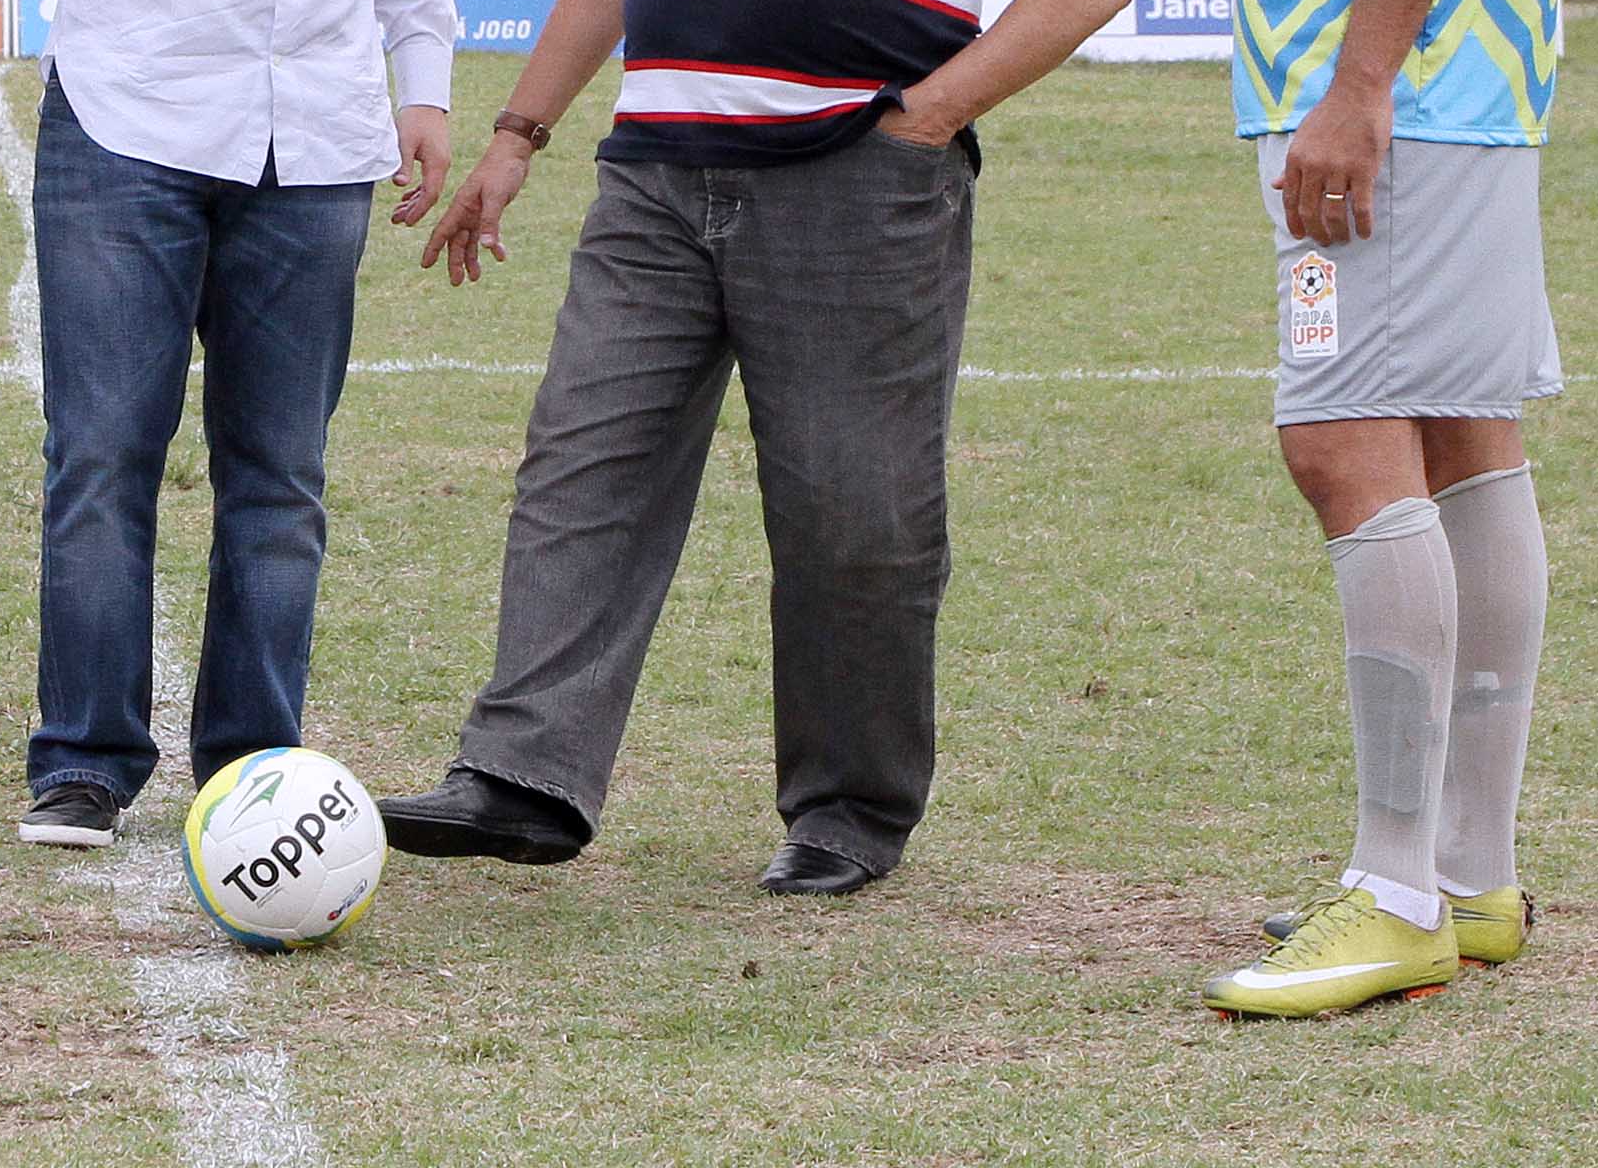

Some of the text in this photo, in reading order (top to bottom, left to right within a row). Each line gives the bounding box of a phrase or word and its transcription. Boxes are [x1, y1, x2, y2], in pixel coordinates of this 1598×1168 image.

[472, 19, 532, 41] JOGO
[1293, 326, 1333, 345] UPP
[221, 779, 356, 903] Topper
